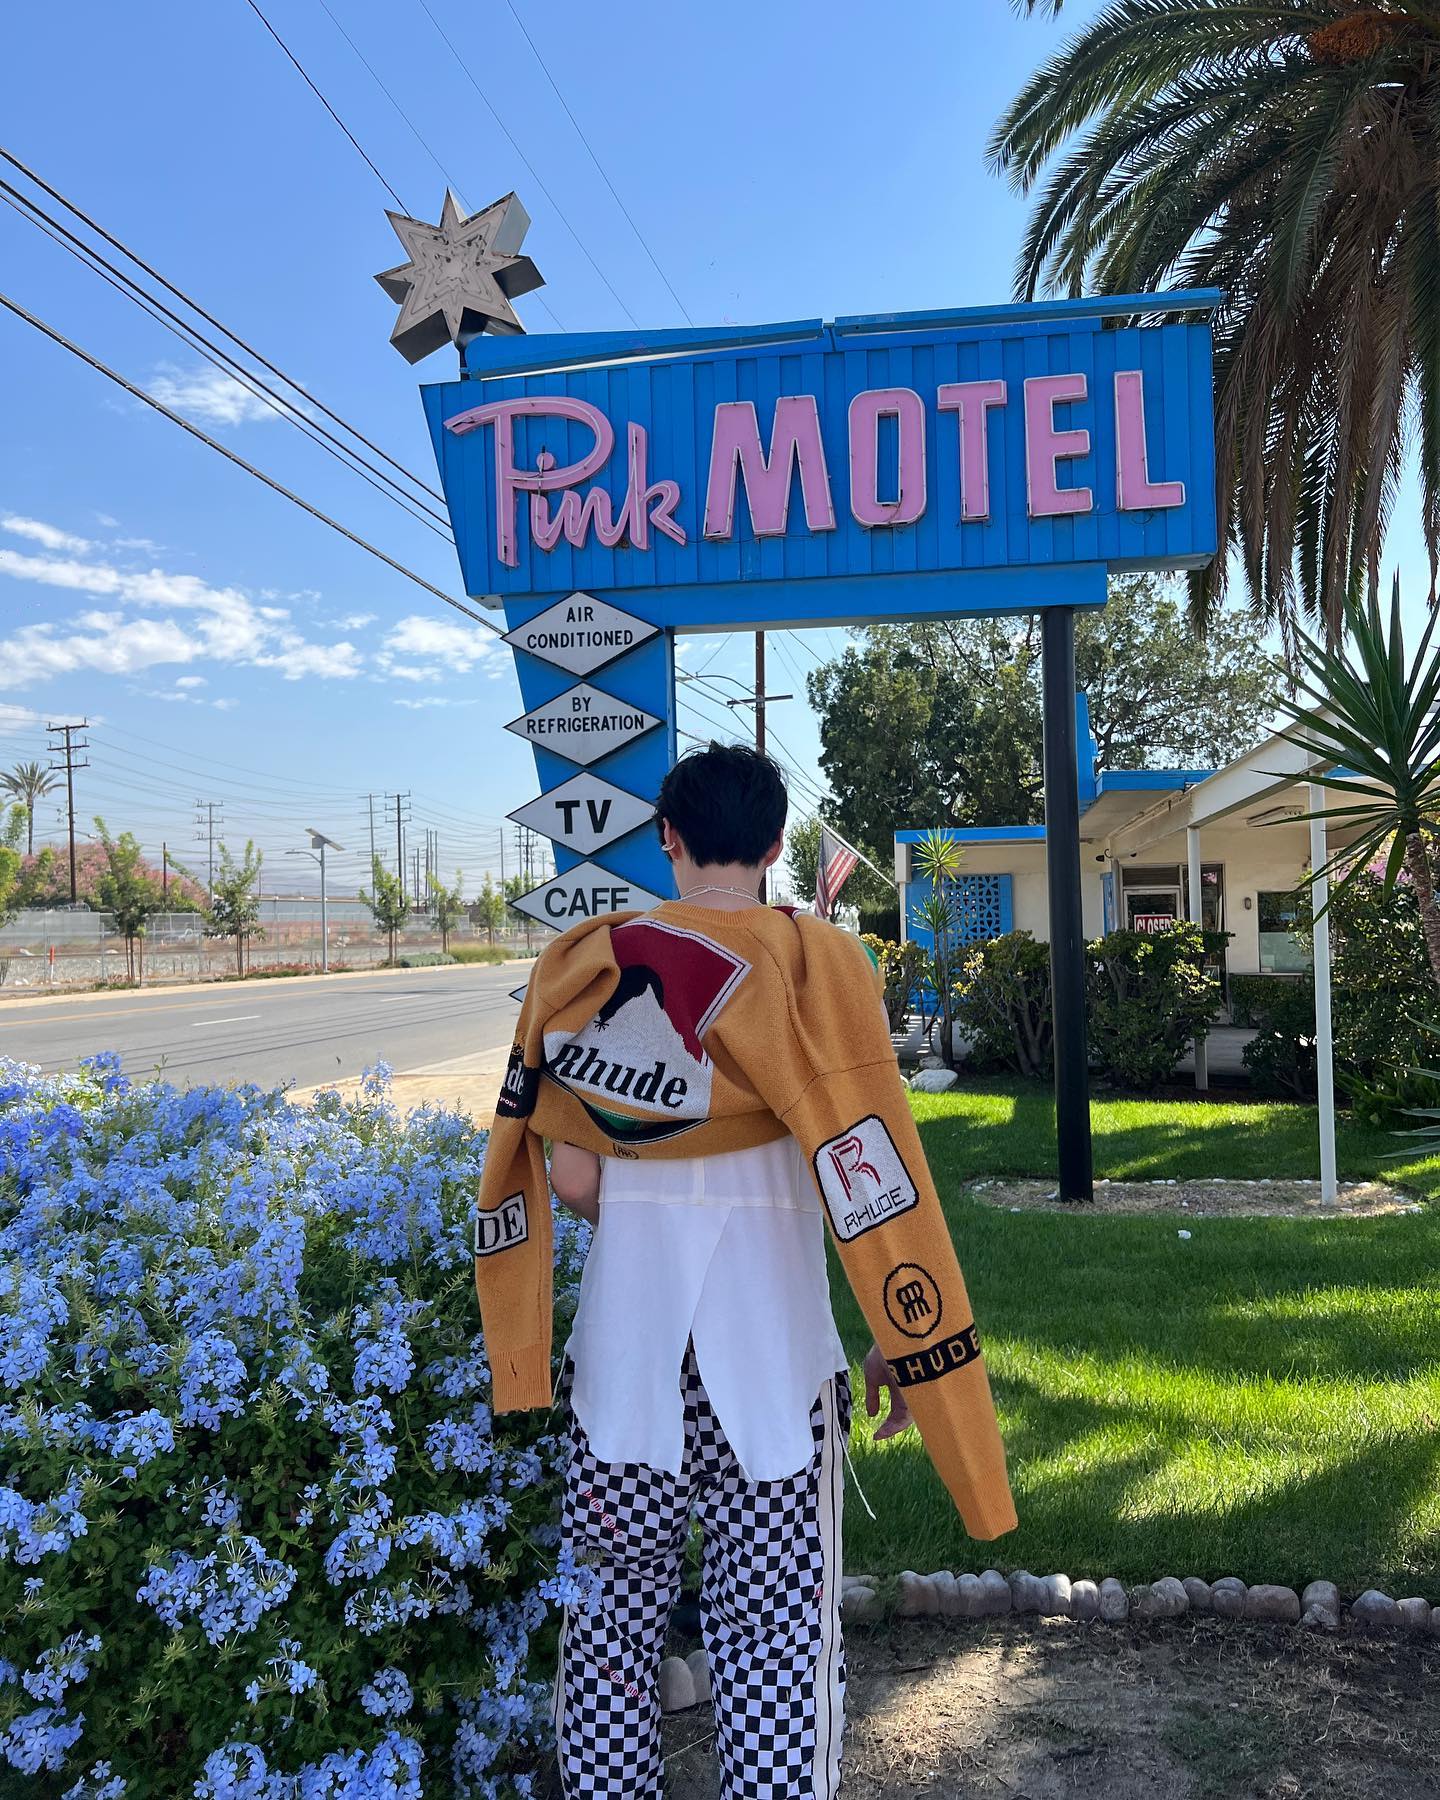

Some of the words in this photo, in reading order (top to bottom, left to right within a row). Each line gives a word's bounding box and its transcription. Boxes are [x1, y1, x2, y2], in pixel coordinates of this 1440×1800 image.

[443, 396, 686, 567] Pink
[703, 370, 1186, 541] MOTEL
[566, 606, 594, 623] AIR
[527, 630, 633, 649] CONDITIONED
[572, 697, 591, 712] BY
[527, 714, 644, 734] REFRIGERATION
[555, 799, 612, 835] TV
[548, 1043, 688, 1109] Rhude
[844, 1186, 906, 1234] RHUDE
